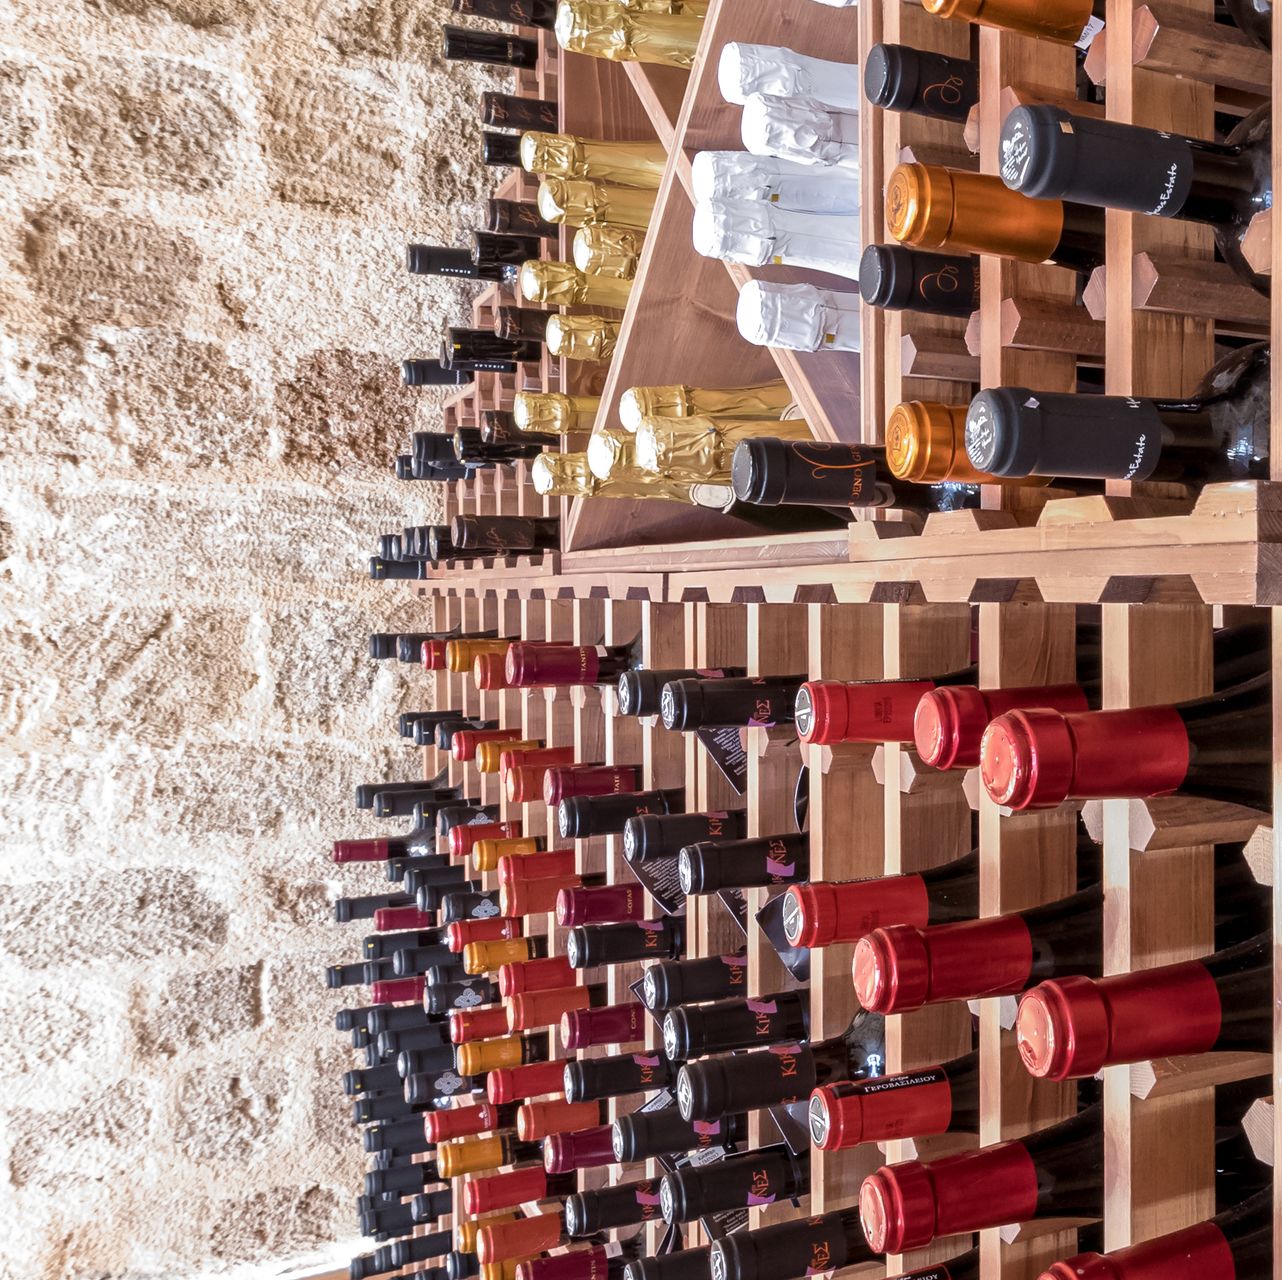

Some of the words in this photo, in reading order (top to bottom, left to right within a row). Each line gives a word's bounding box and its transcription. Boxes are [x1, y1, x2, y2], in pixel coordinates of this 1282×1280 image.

[1159, 162, 1179, 200] Estate
[1128, 432, 1147, 470] Estate
[864, 1074, 937, 1094] ΓΕΡΟΒΑΣΙΛΕΙΟΥ
